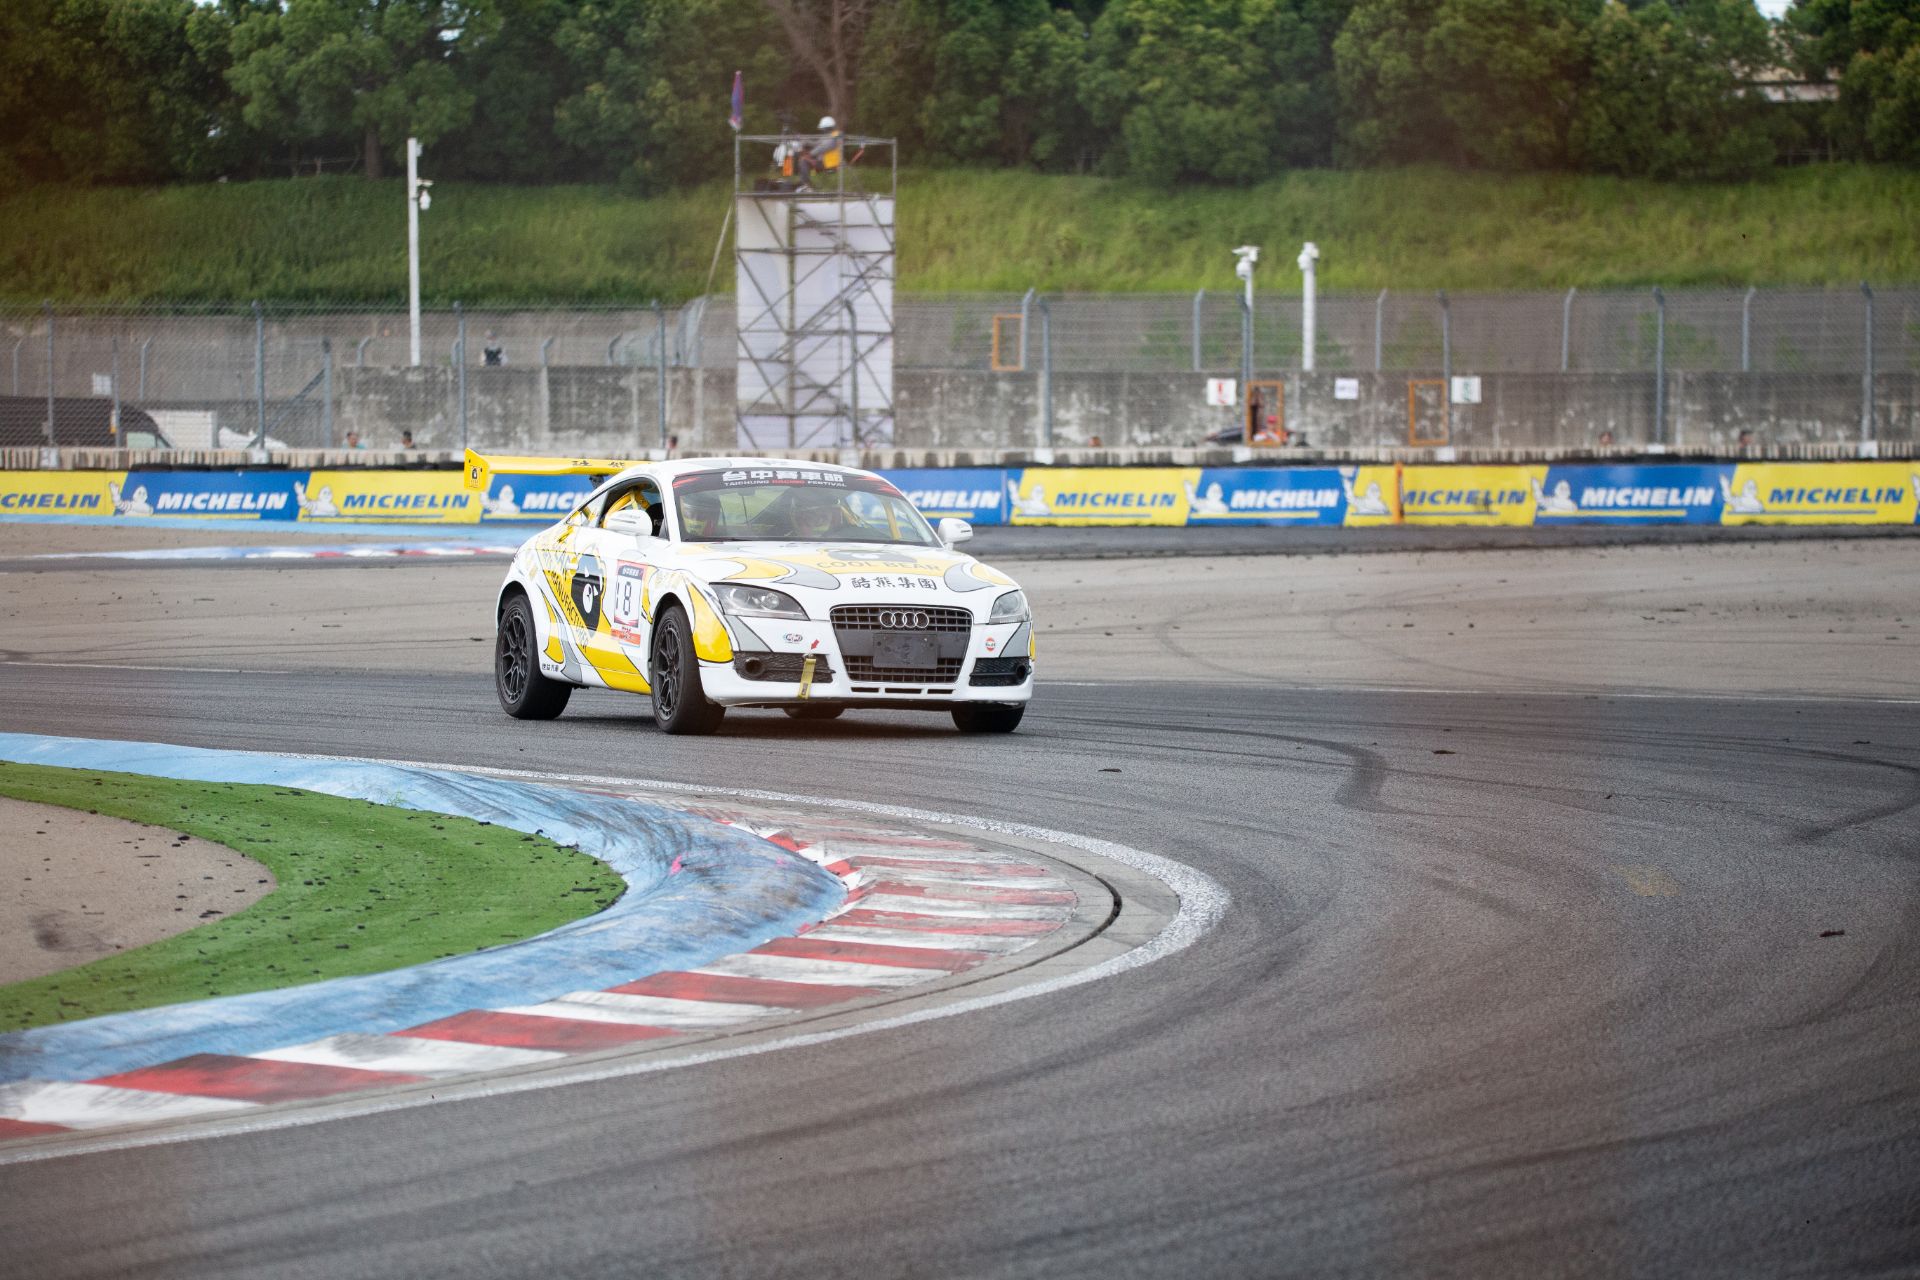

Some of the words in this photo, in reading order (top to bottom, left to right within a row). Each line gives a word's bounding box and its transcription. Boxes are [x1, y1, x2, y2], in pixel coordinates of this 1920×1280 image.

[724, 479, 769, 487] TAICHUNG
[807, 480, 847, 488] FESTIVAL
[0, 493, 101, 509] CHELIN
[156, 492, 289, 510] MICHELIN
[342, 494, 470, 509] MICHELIN
[1055, 492, 1176, 507] MICHELIN
[1231, 489, 1340, 509] MICHELIN
[1581, 488, 1715, 506] MICHELIN
[1768, 488, 1905, 505] MICHELIN
[817, 561, 877, 569] COOL
[883, 561, 941, 571] BEAR
[851, 576, 938, 591] 酷熊集團
